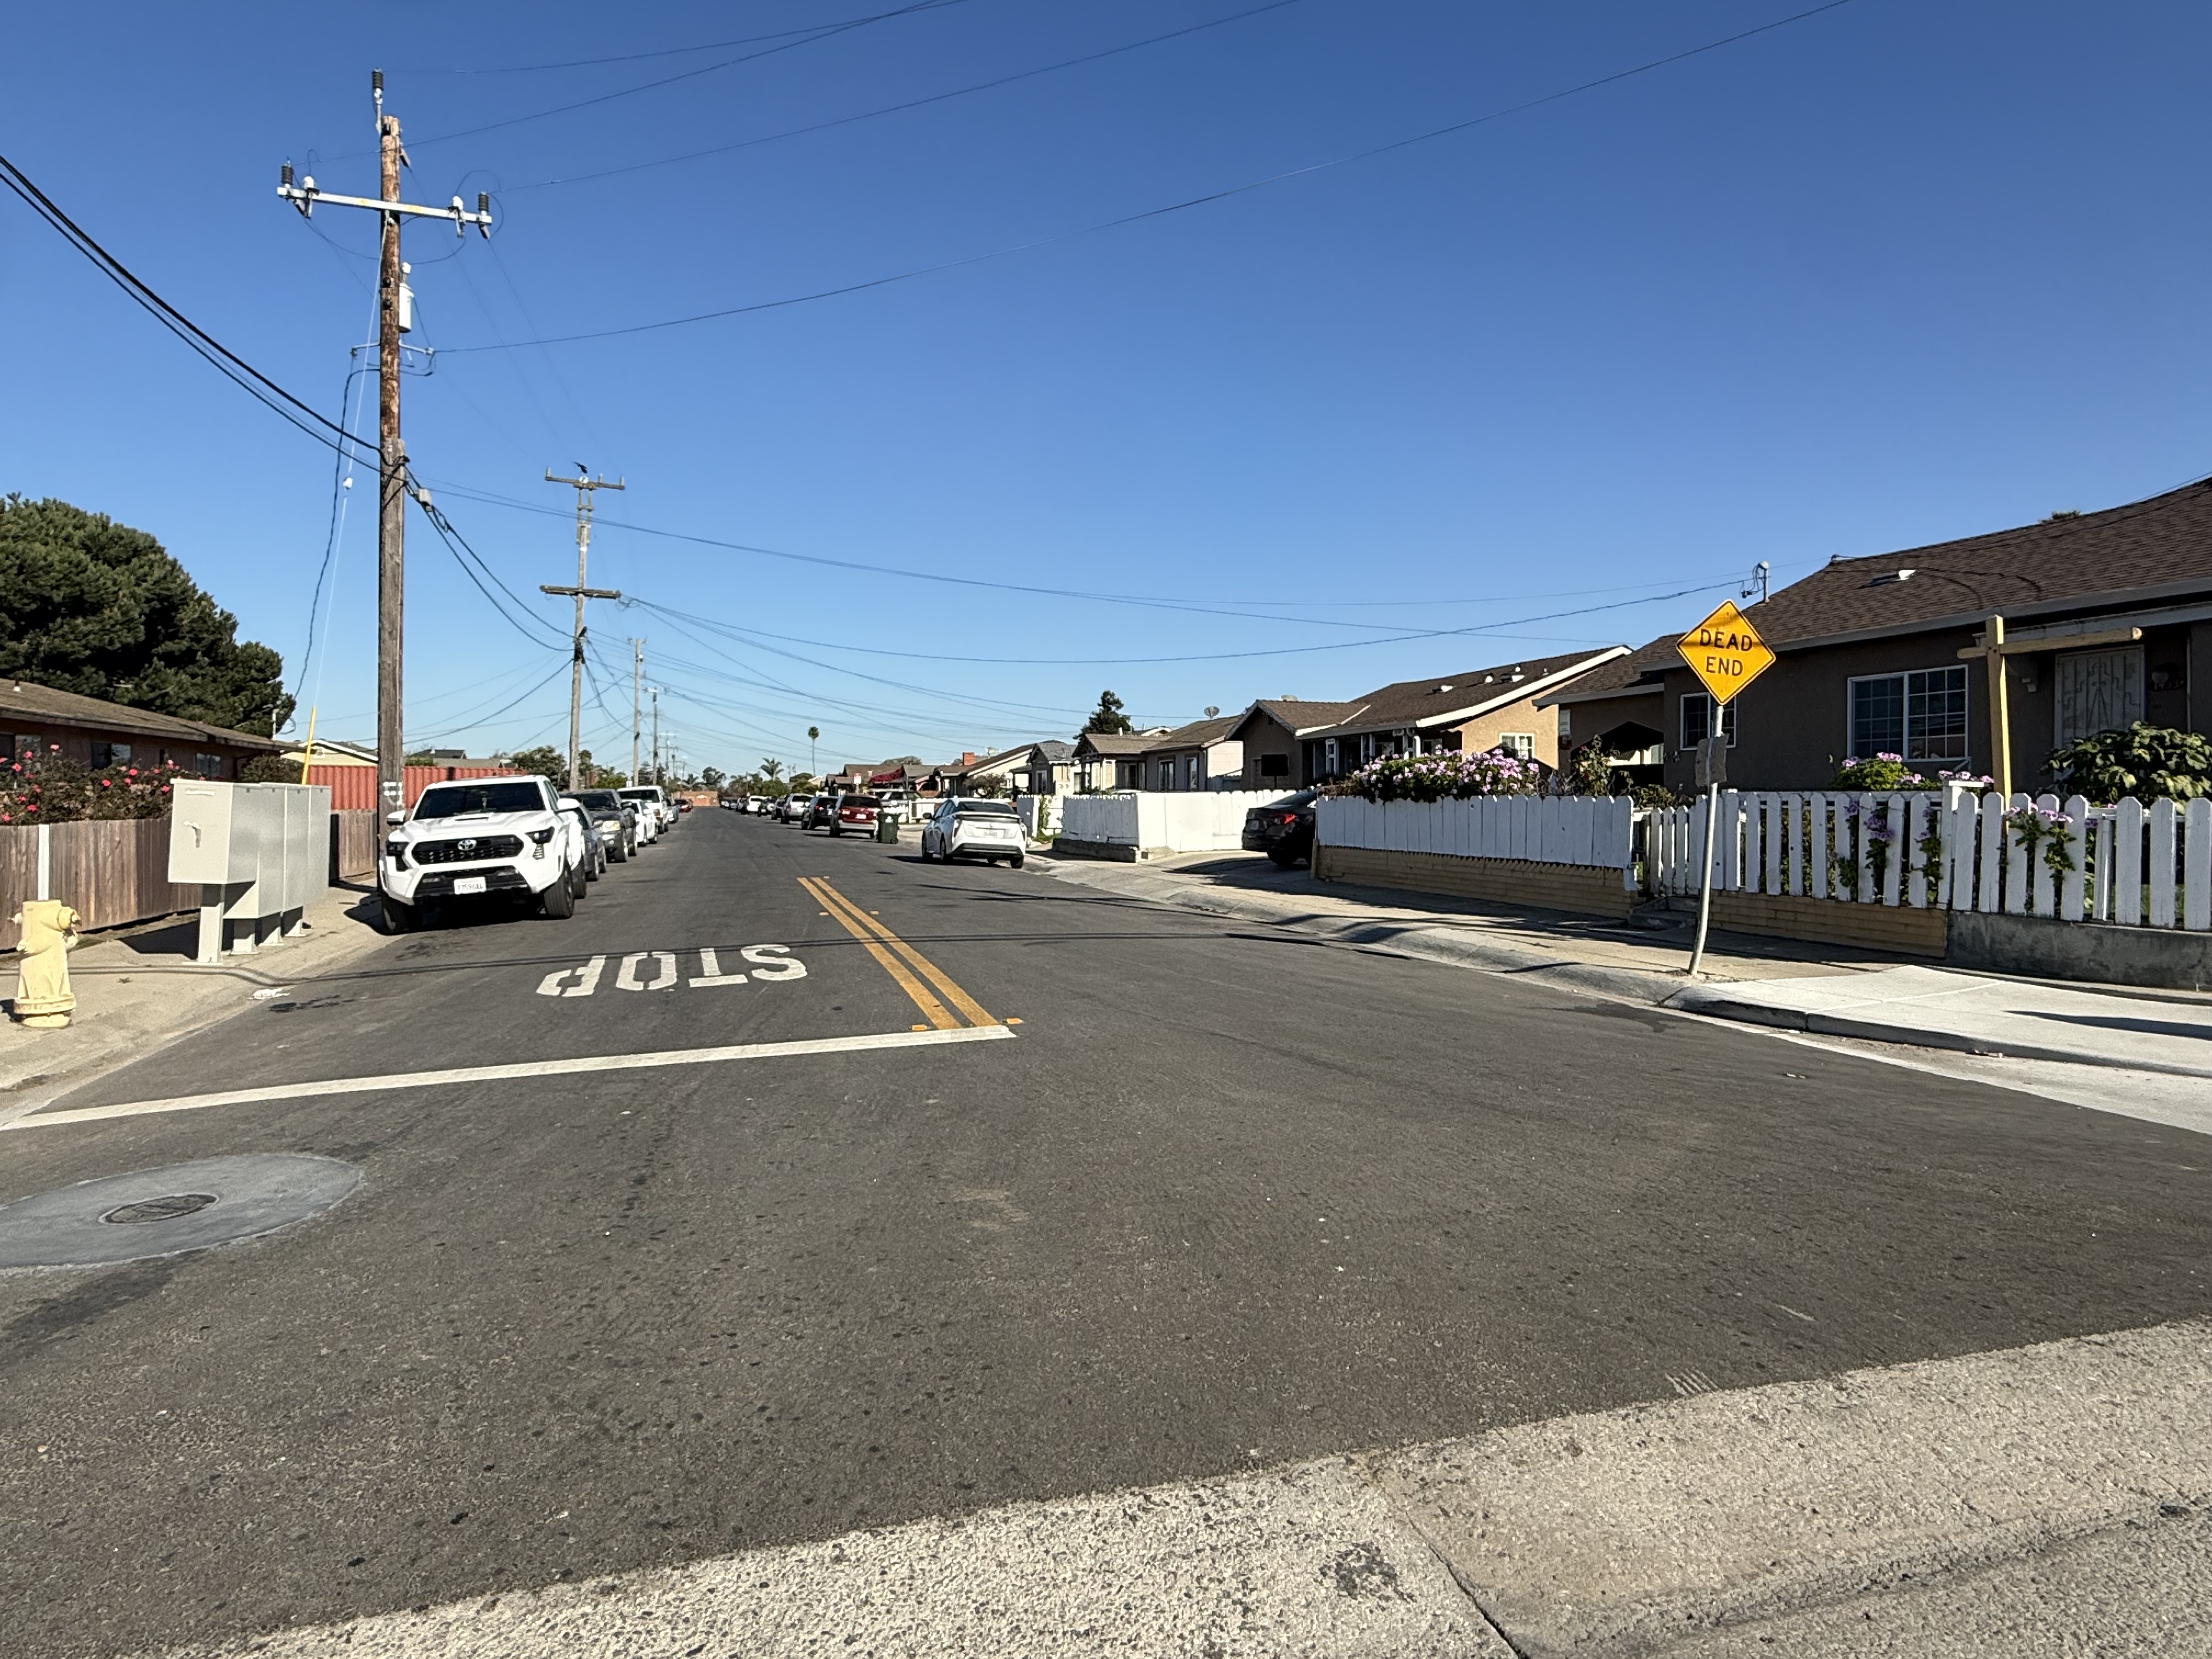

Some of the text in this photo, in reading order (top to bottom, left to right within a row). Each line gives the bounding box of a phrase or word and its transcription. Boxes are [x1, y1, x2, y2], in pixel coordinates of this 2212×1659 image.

[1700, 629, 1753, 652] DEAD
[1706, 656, 1743, 677] END
[535, 944, 808, 997] STOP
